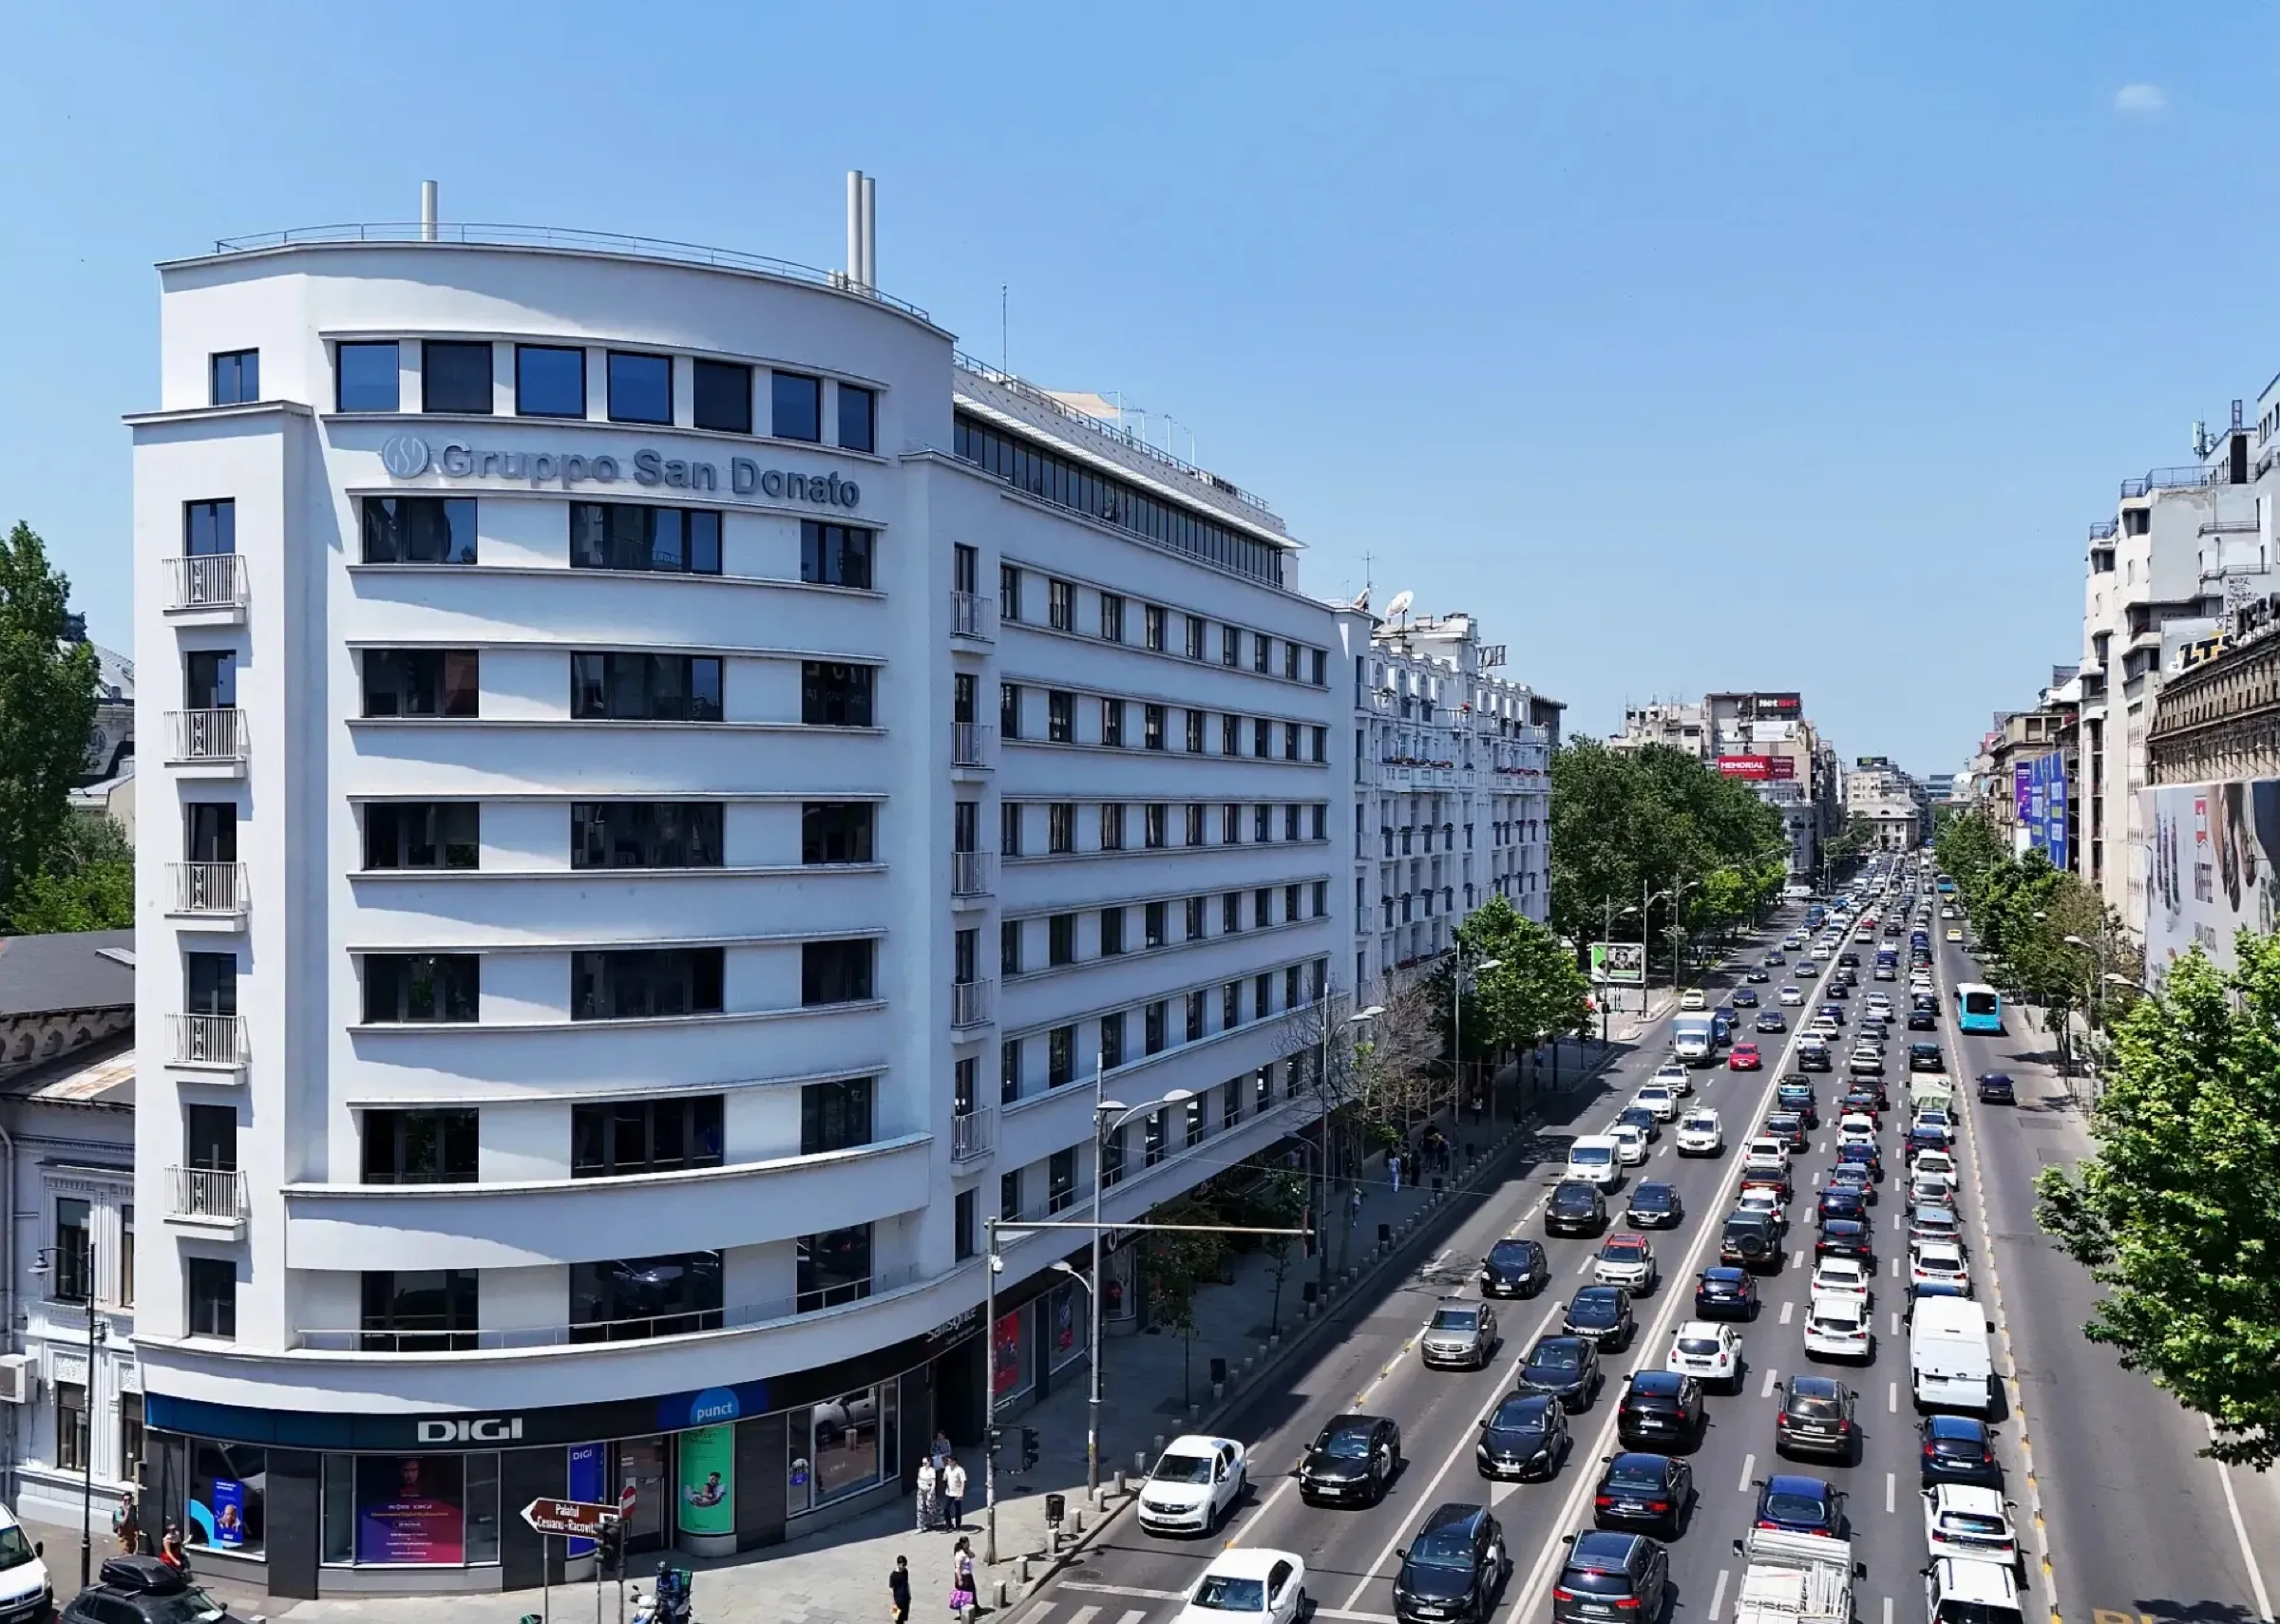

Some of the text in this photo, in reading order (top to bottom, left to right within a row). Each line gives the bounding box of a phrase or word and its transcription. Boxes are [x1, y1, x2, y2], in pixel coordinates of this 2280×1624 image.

[443, 438, 861, 508] Gruppo San Donato
[696, 1401, 732, 1422] punct
[418, 1417, 522, 1443] DIGI
[573, 1448, 593, 1460] DIGI
[555, 1503, 580, 1518] Palatul
